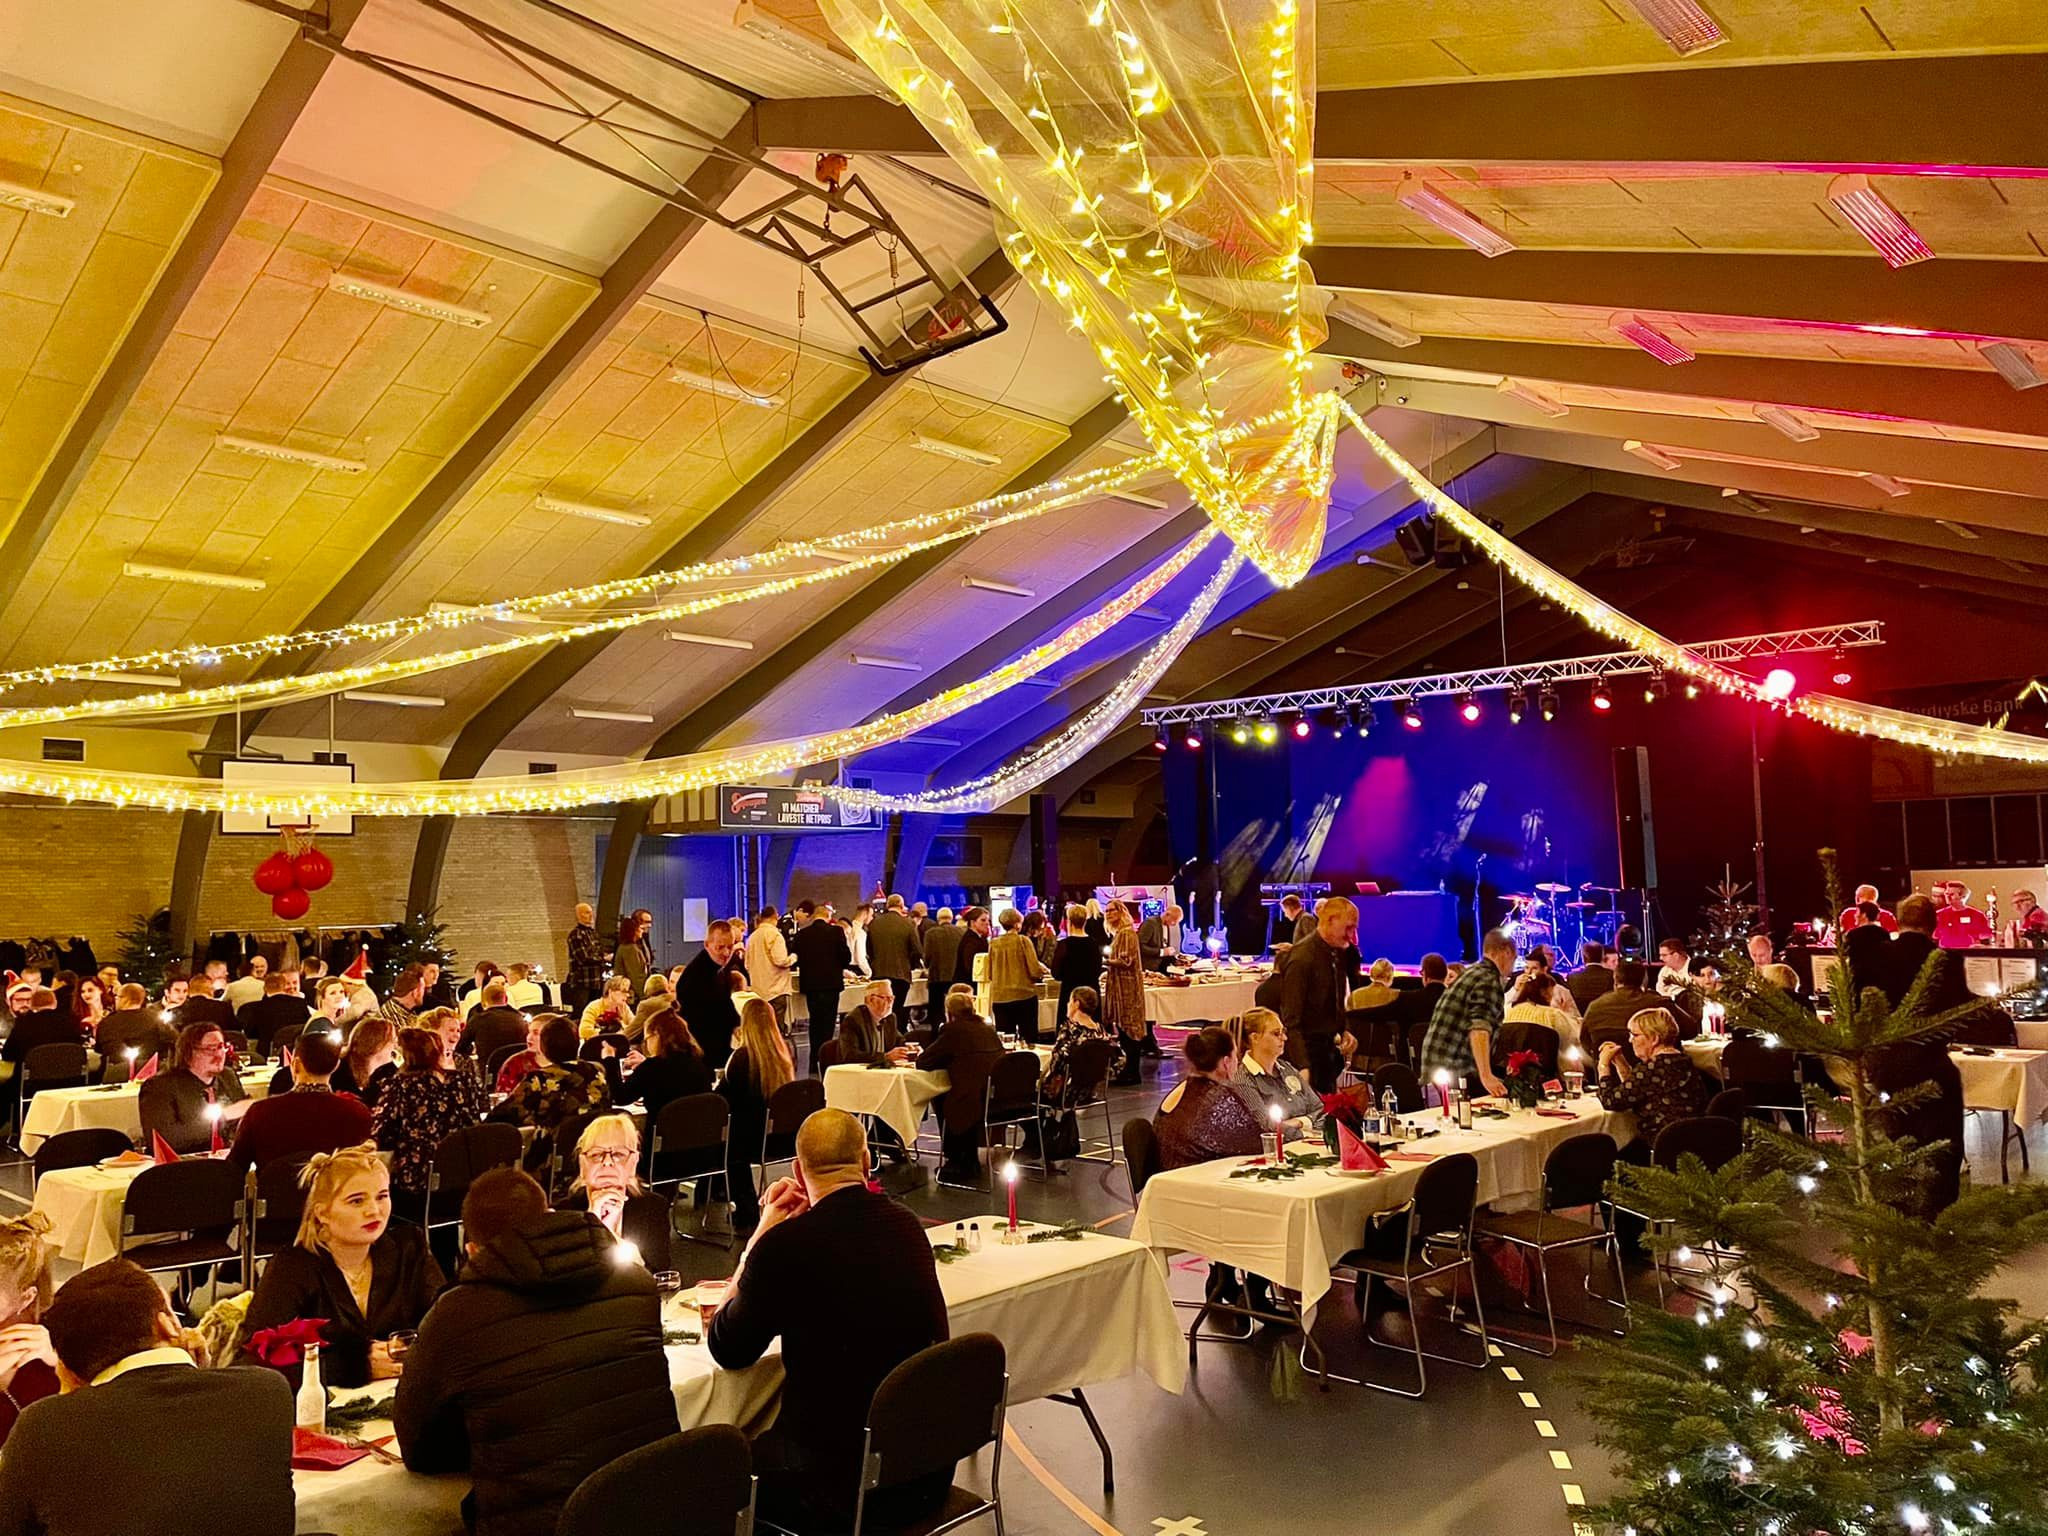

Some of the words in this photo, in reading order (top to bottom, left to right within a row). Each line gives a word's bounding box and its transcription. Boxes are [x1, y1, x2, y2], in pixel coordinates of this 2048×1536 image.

[1901, 701, 1979, 719] ordjyske
[1984, 697, 2024, 713] Bank
[790, 803, 819, 813] MATCHER
[777, 813, 804, 823] LAVESTE
